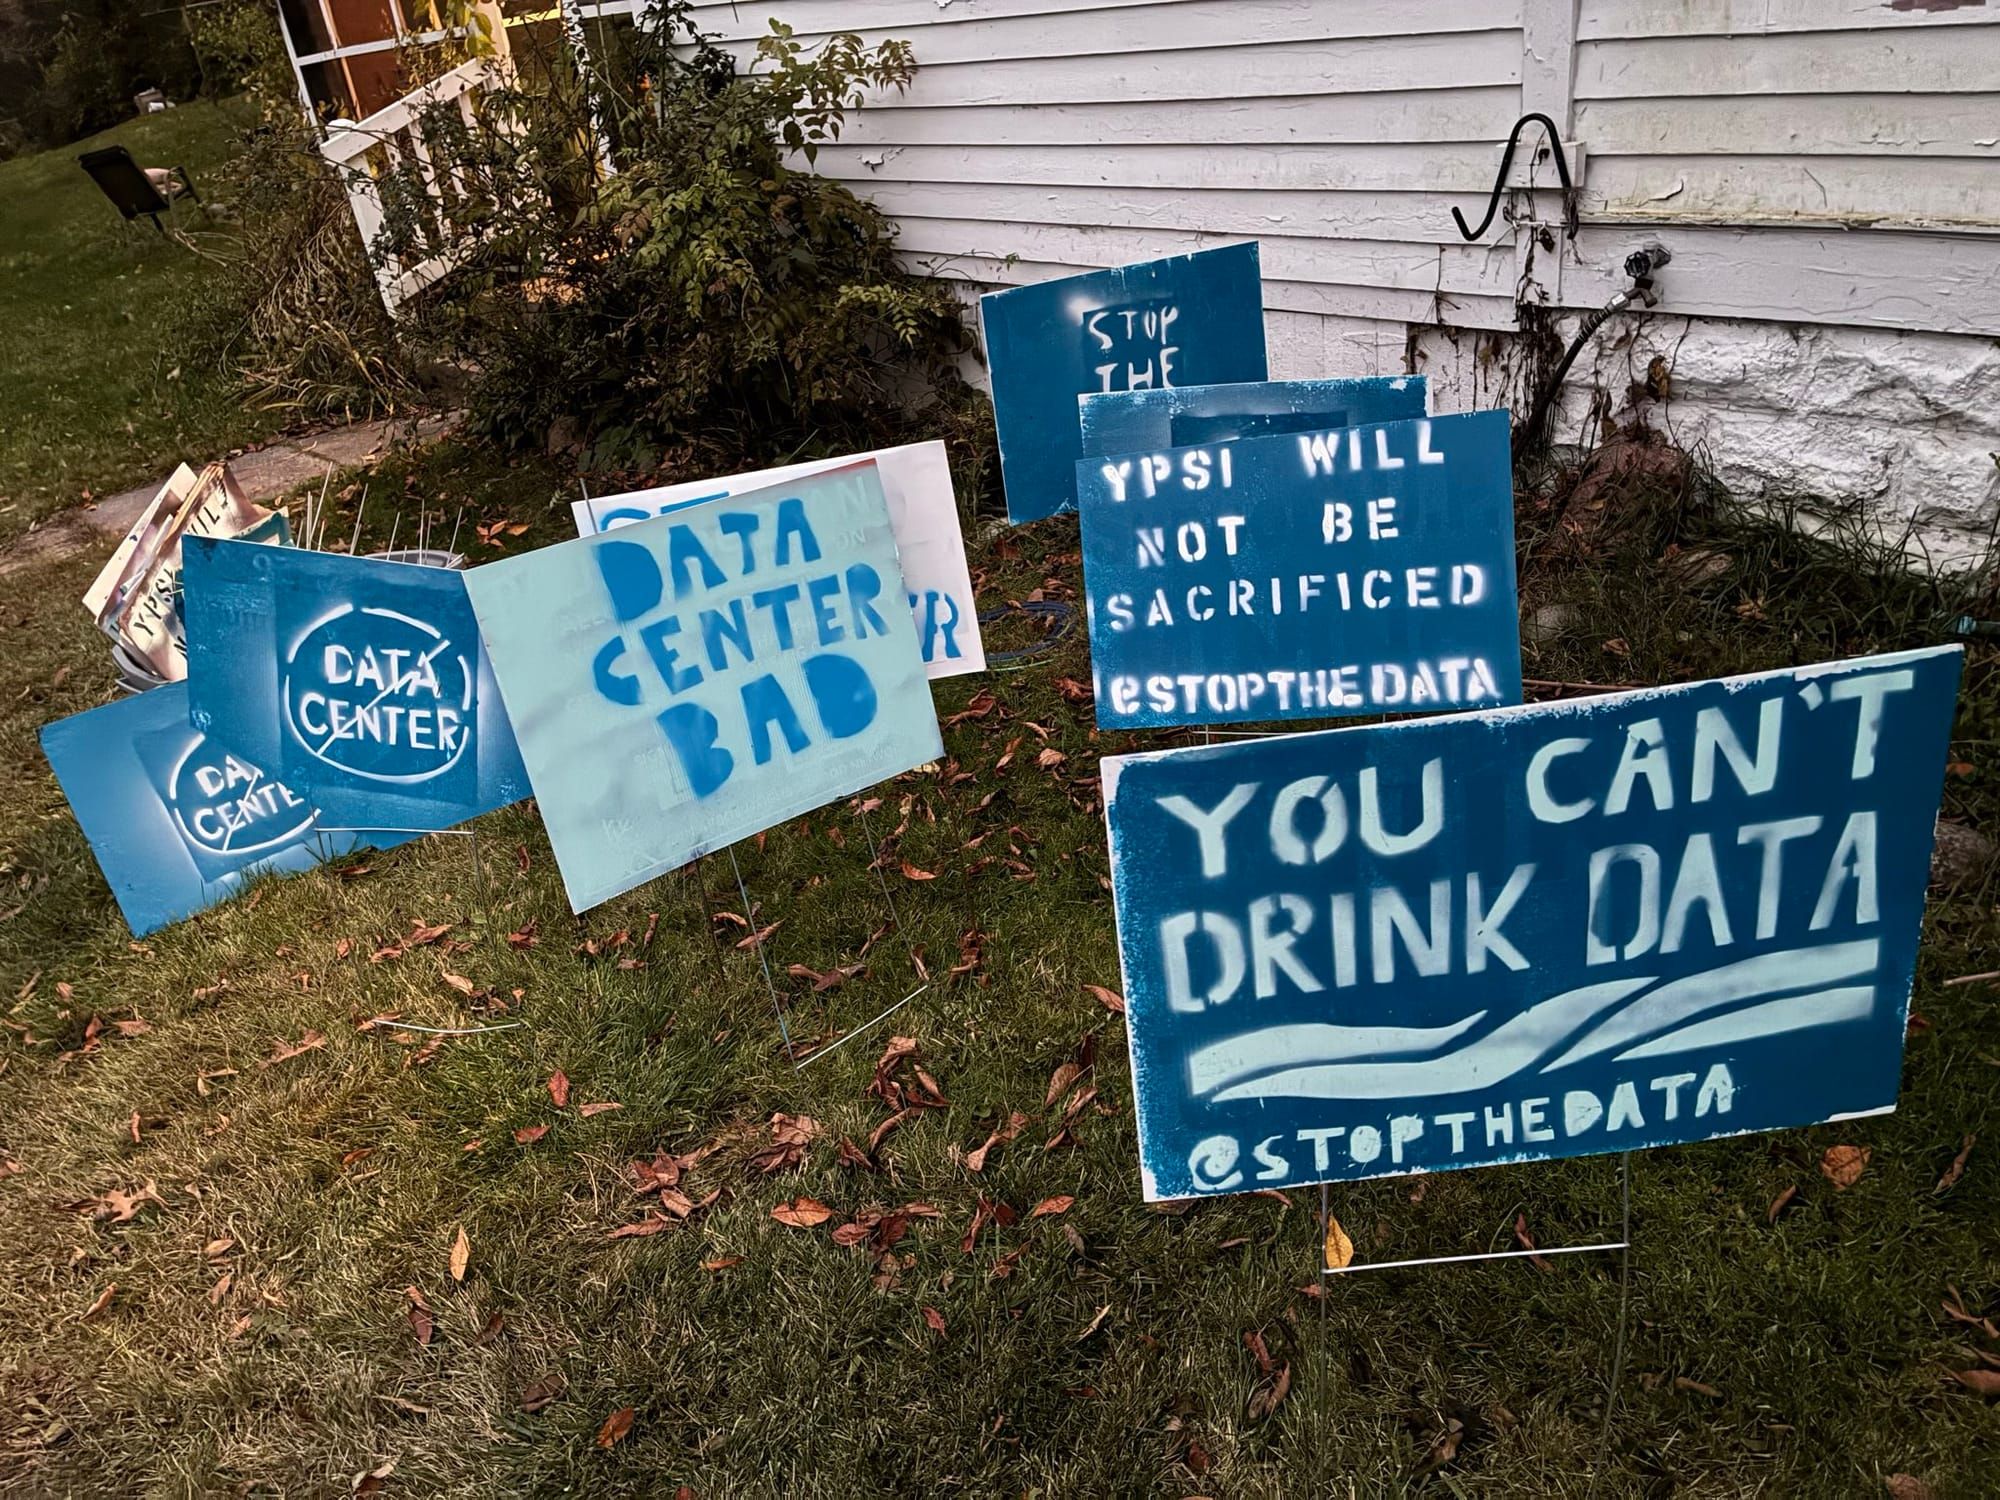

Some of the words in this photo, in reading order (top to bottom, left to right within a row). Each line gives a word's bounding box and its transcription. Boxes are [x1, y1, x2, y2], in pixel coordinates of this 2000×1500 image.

[1088, 305, 1178, 350] STOP
[1095, 346, 1179, 392] THE
[1102, 447, 1233, 502] YPSI
[1298, 420, 1444, 477] WILL
[594, 498, 821, 622] DATA
[1136, 513, 1245, 569] NOT
[1321, 497, 1399, 544] BE
[592, 562, 889, 706] CENTER
[1107, 564, 1485, 633] SACRIFICED
[324, 645, 443, 699] DATA
[300, 692, 461, 751] CENTER
[656, 653, 878, 799] BAD
[1157, 757, 1445, 878] YOU
[1525, 669, 1914, 825] CAN'T
[1161, 863, 1537, 1013] DRINK
[1585, 810, 1881, 967] DATA
[1188, 1064, 1736, 1190] @STOPTHEDATA
